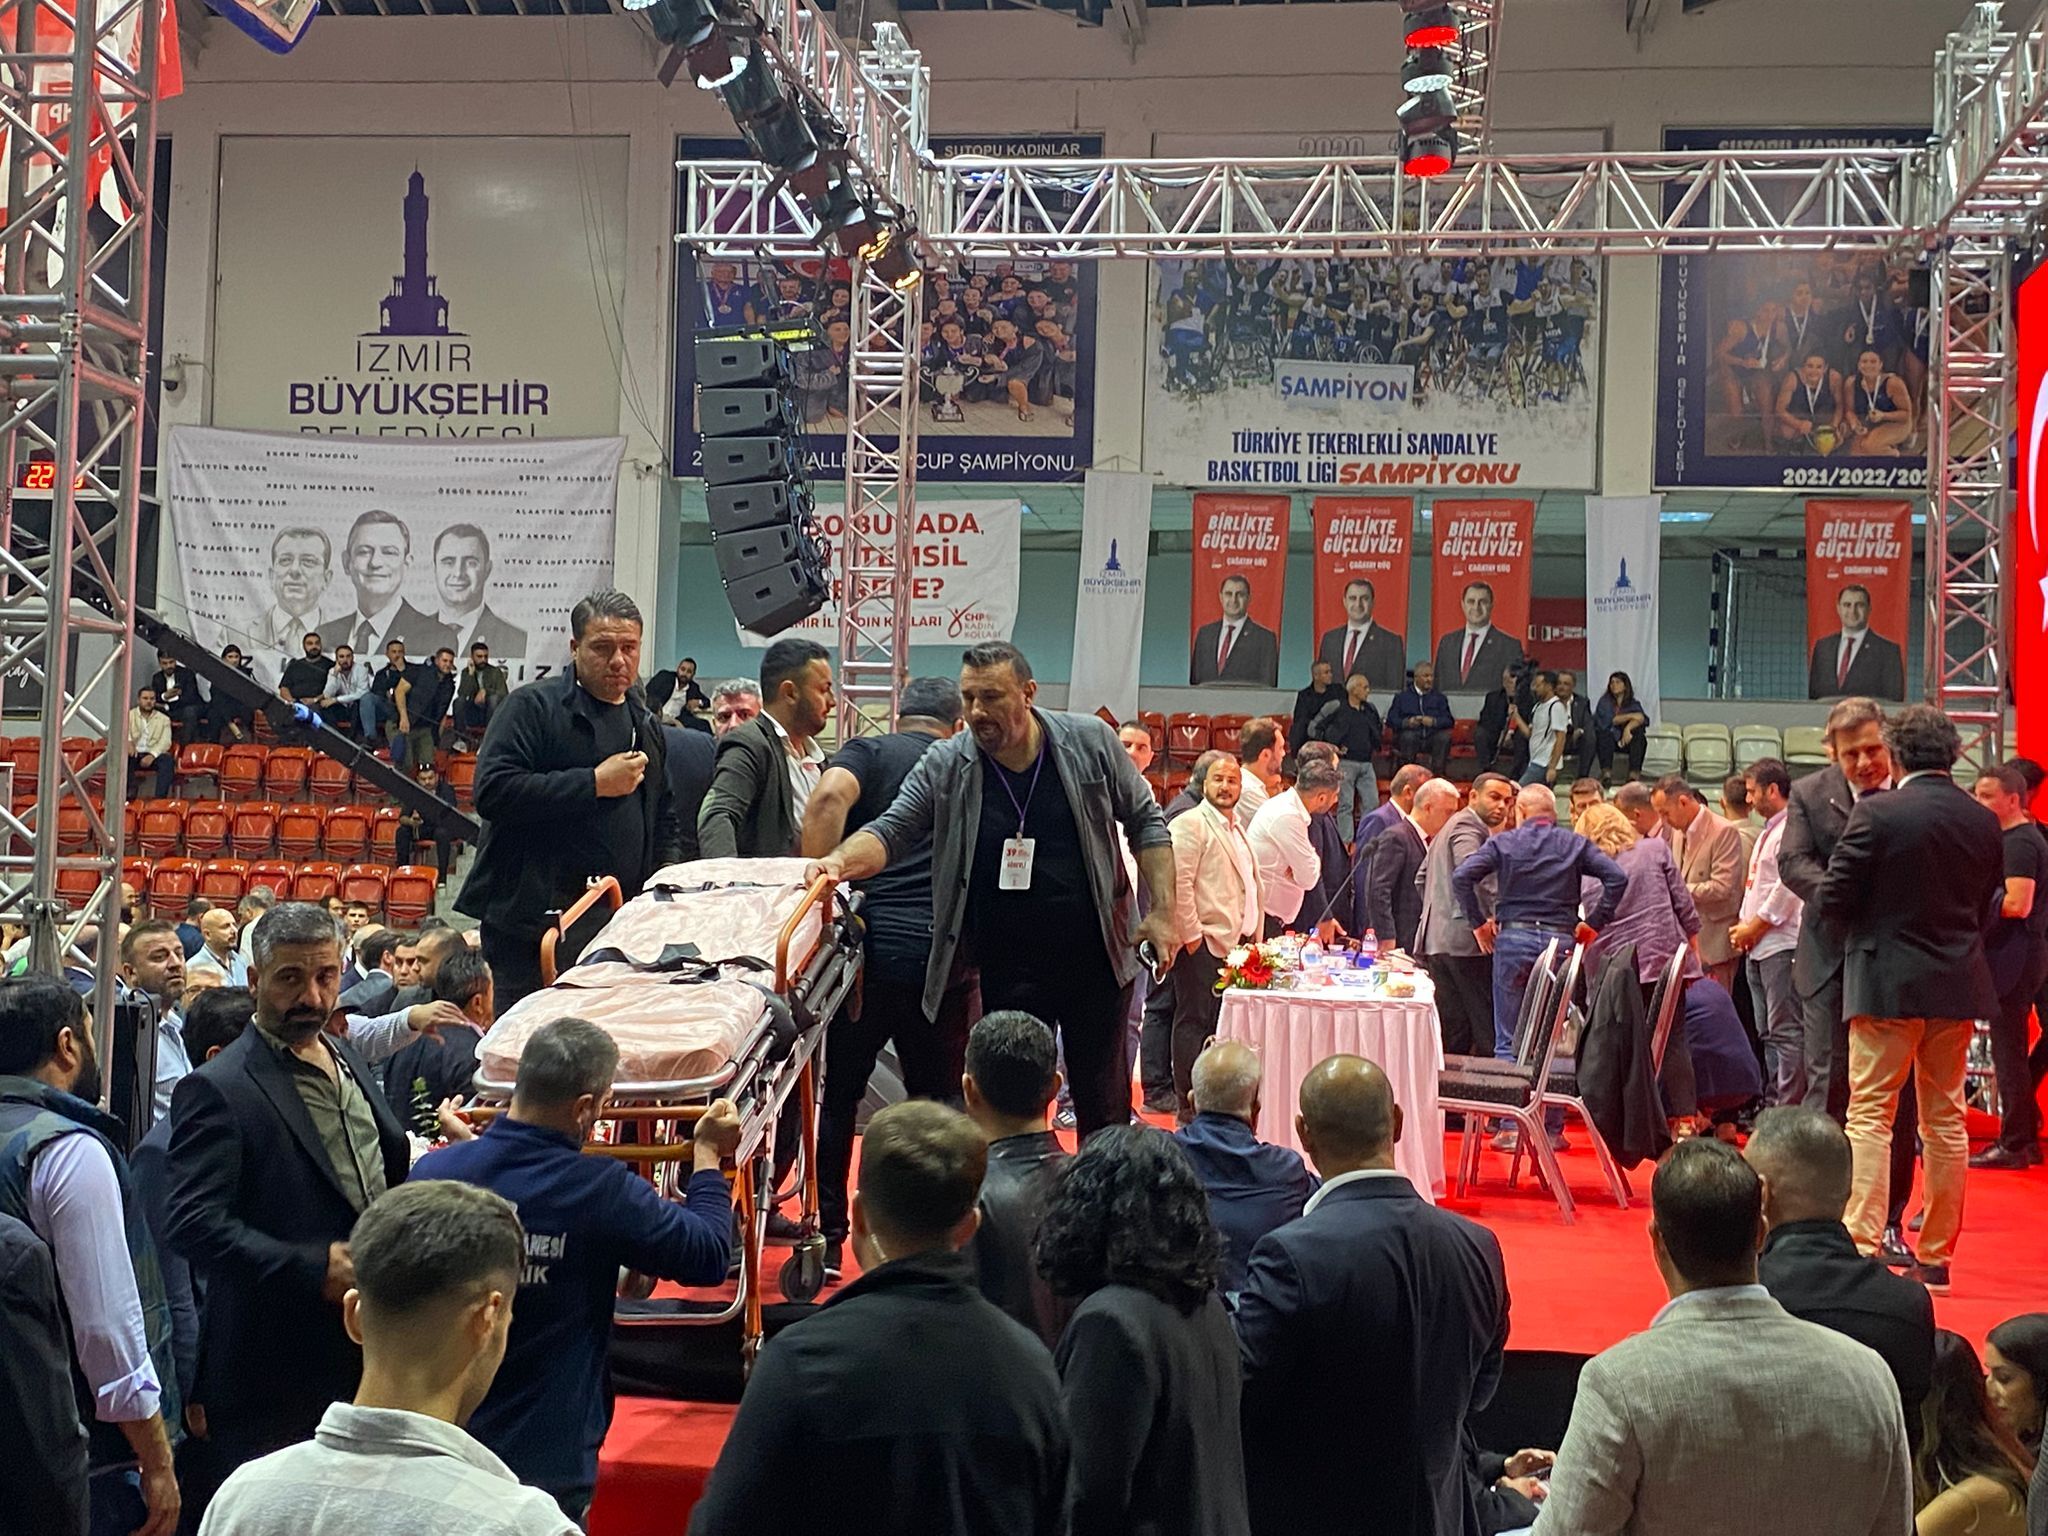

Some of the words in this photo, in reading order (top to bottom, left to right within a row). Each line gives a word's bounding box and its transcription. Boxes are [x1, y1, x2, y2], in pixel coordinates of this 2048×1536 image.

[944, 144, 1002, 158] SUTOPU
[1006, 143, 1081, 156] KADINLAR
[356, 340, 472, 372] İZMİR
[289, 376, 550, 420] BÜYÜKŞEHİR
[1280, 372, 1408, 402] ŞAMPİYON
[1231, 426, 1302, 454] TÜRKİYE
[1307, 427, 1403, 455] TEKERLEKLİ
[1406, 433, 1499, 455] SANDALYE
[916, 453, 954, 470] CUP
[959, 451, 1075, 474] ŞAMPİYONU
[1207, 460, 1302, 483] BASKETBOL
[1307, 456, 1338, 483] LİGİ
[859, 512, 985, 537] BUADA,
[1207, 511, 1275, 532] BİRLİKTE
[1329, 515, 1398, 535] BİRLİKTE
[1447, 518, 1518, 538] BİRLİKTE
[1821, 518, 1896, 540] BİRLİKTE
[1200, 530, 1280, 554] GÜÇLÜYÜZ!
[1322, 533, 1403, 558] GÜÇLÜYÜZ!
[1441, 536, 1523, 561] GÜÇLÜYÜZ!
[1815, 538, 1902, 563] GÜÇLÜYÜZ!
[964, 613, 985, 621] CHP
